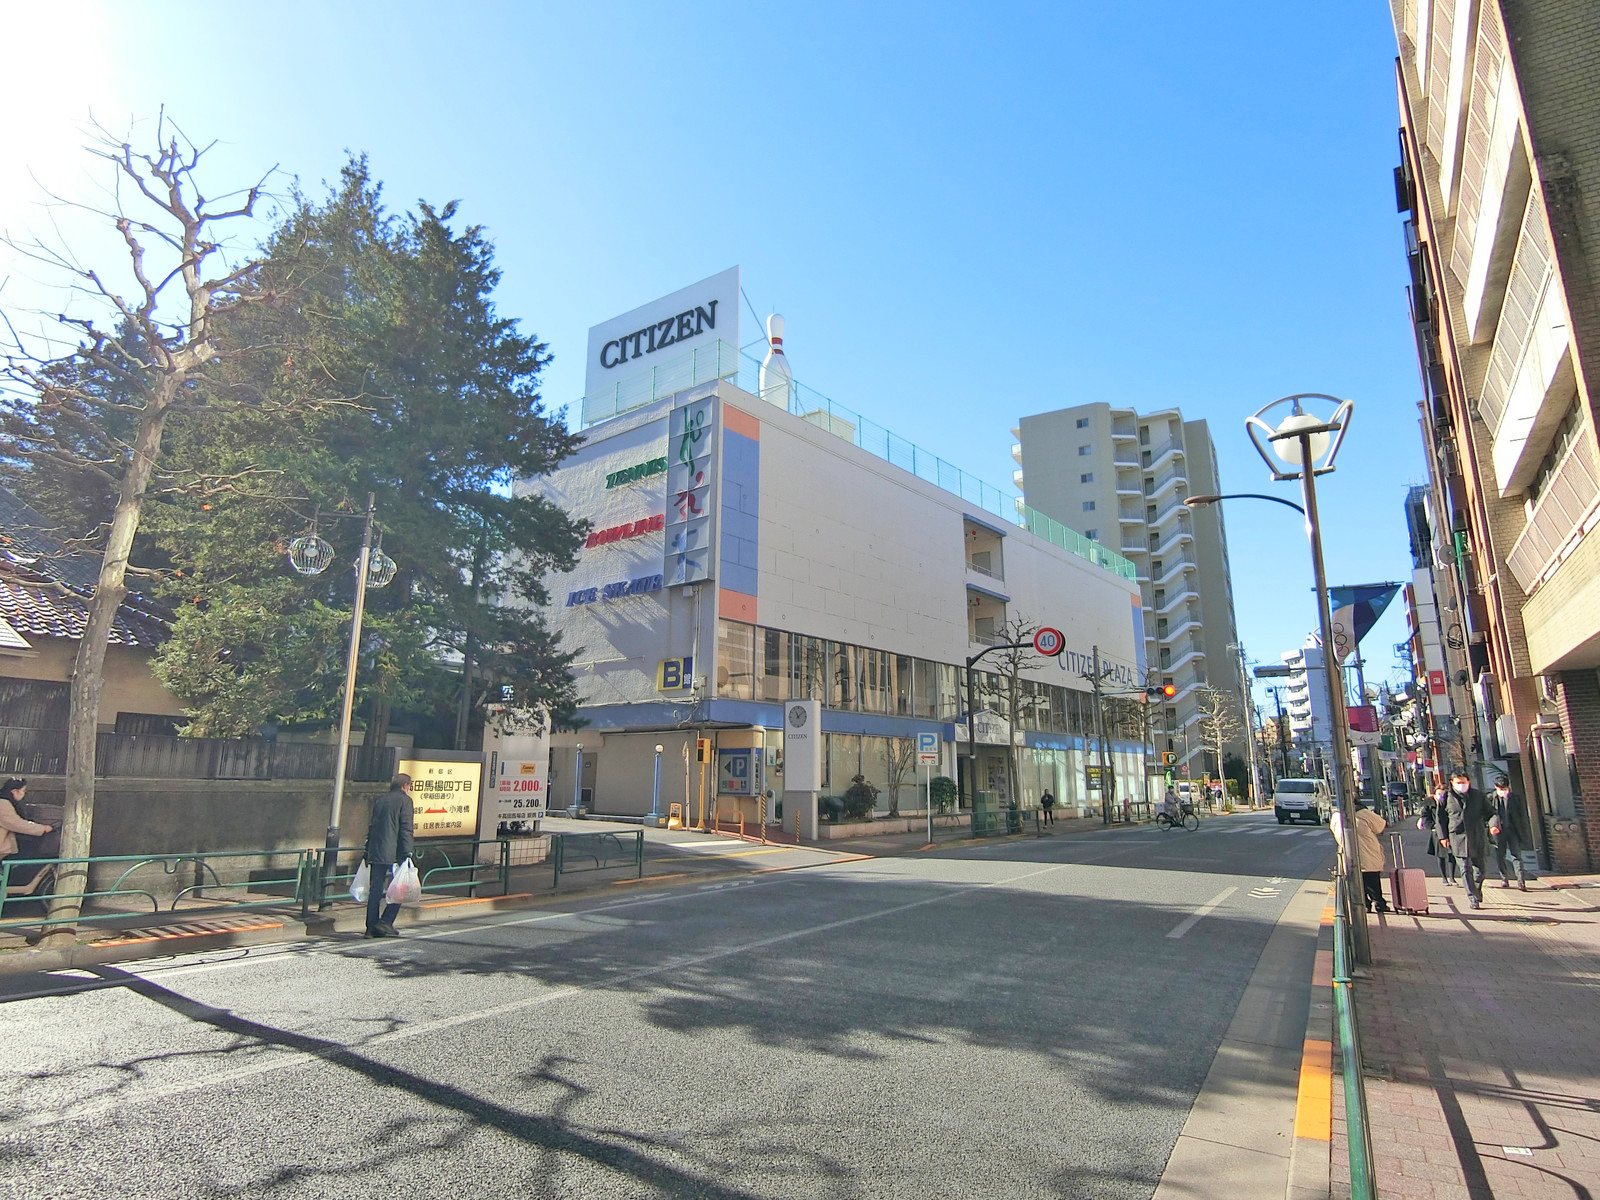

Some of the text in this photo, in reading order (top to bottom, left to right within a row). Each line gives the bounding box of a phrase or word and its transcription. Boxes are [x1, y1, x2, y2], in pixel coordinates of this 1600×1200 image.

[600, 300, 718, 369] CITIZEN
[605, 456, 668, 489] TENNIS
[585, 513, 664, 548] BOWLING
[566, 574, 662, 607] ICE SKATE
[1040, 634, 1055, 647] 40
[1058, 650, 1134, 687] CITIZE PLAZA
[920, 735, 935, 751] P
[1168, 754, 1176, 763] P
[736, 758, 745, 775] P
